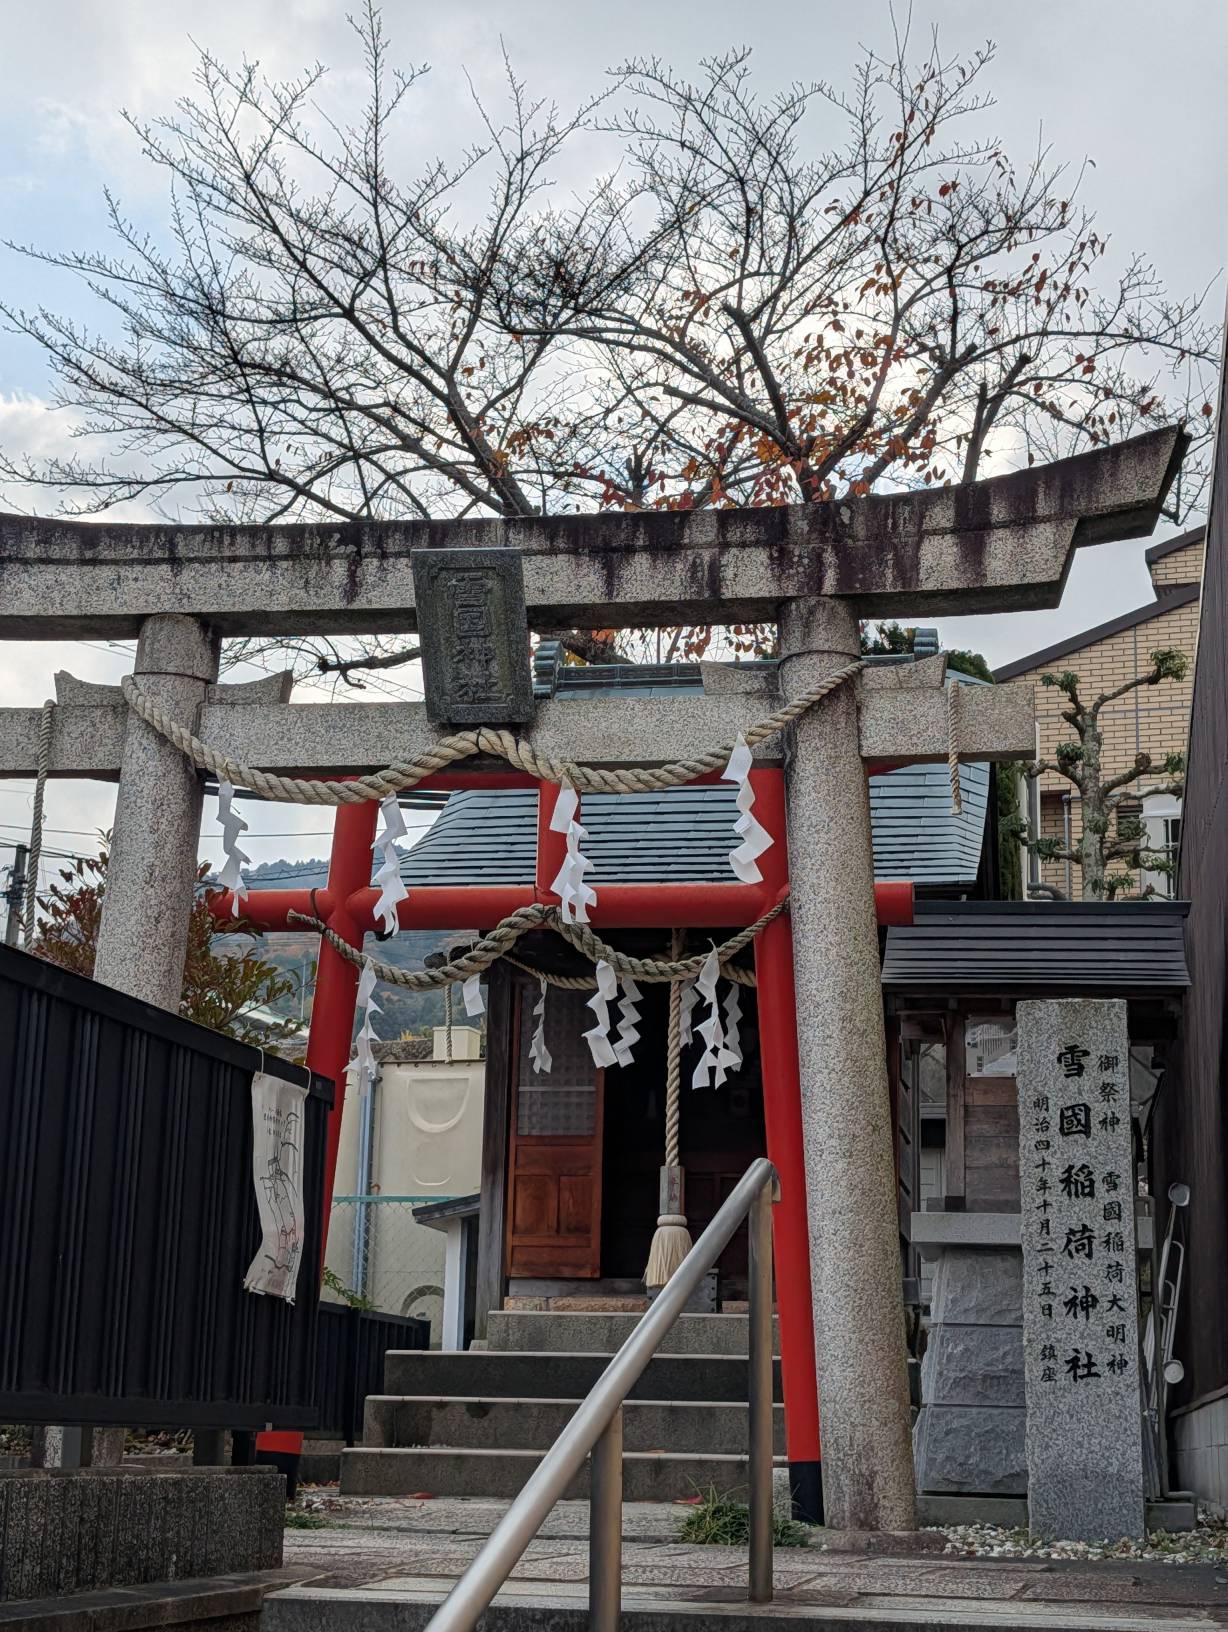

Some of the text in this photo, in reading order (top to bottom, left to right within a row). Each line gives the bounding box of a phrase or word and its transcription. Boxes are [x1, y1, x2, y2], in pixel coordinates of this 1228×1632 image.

[1097, 1054, 1121, 1133] 御祭神
[1033, 1096, 1056, 1318] 明治四十年十月二十五日
[1057, 1044, 1101, 1382] 雪國稲荷神社
